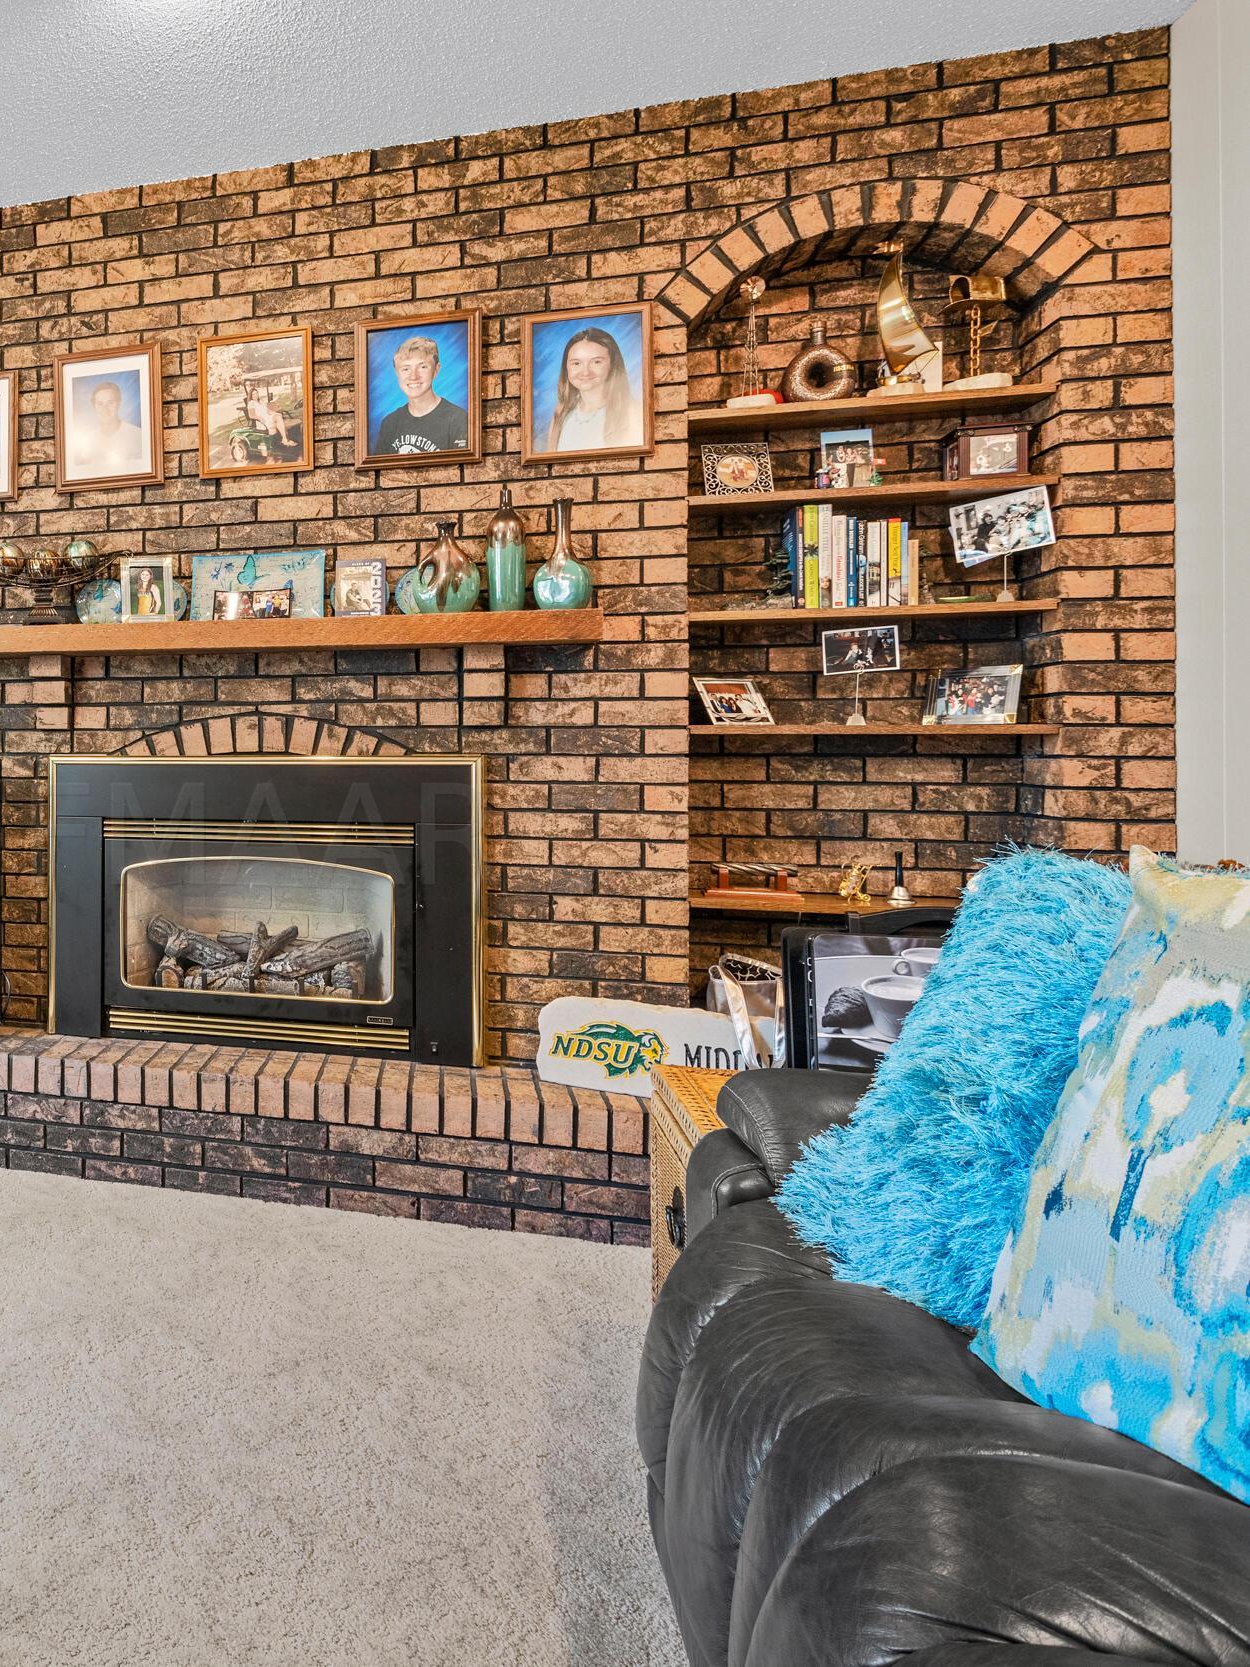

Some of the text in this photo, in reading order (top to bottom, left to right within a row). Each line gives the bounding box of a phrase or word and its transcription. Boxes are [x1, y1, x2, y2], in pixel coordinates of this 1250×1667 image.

[391, 434, 440, 452] YELOWSTON
[371, 561, 382, 616] 2023
[550, 1034, 640, 1067] NDSU
